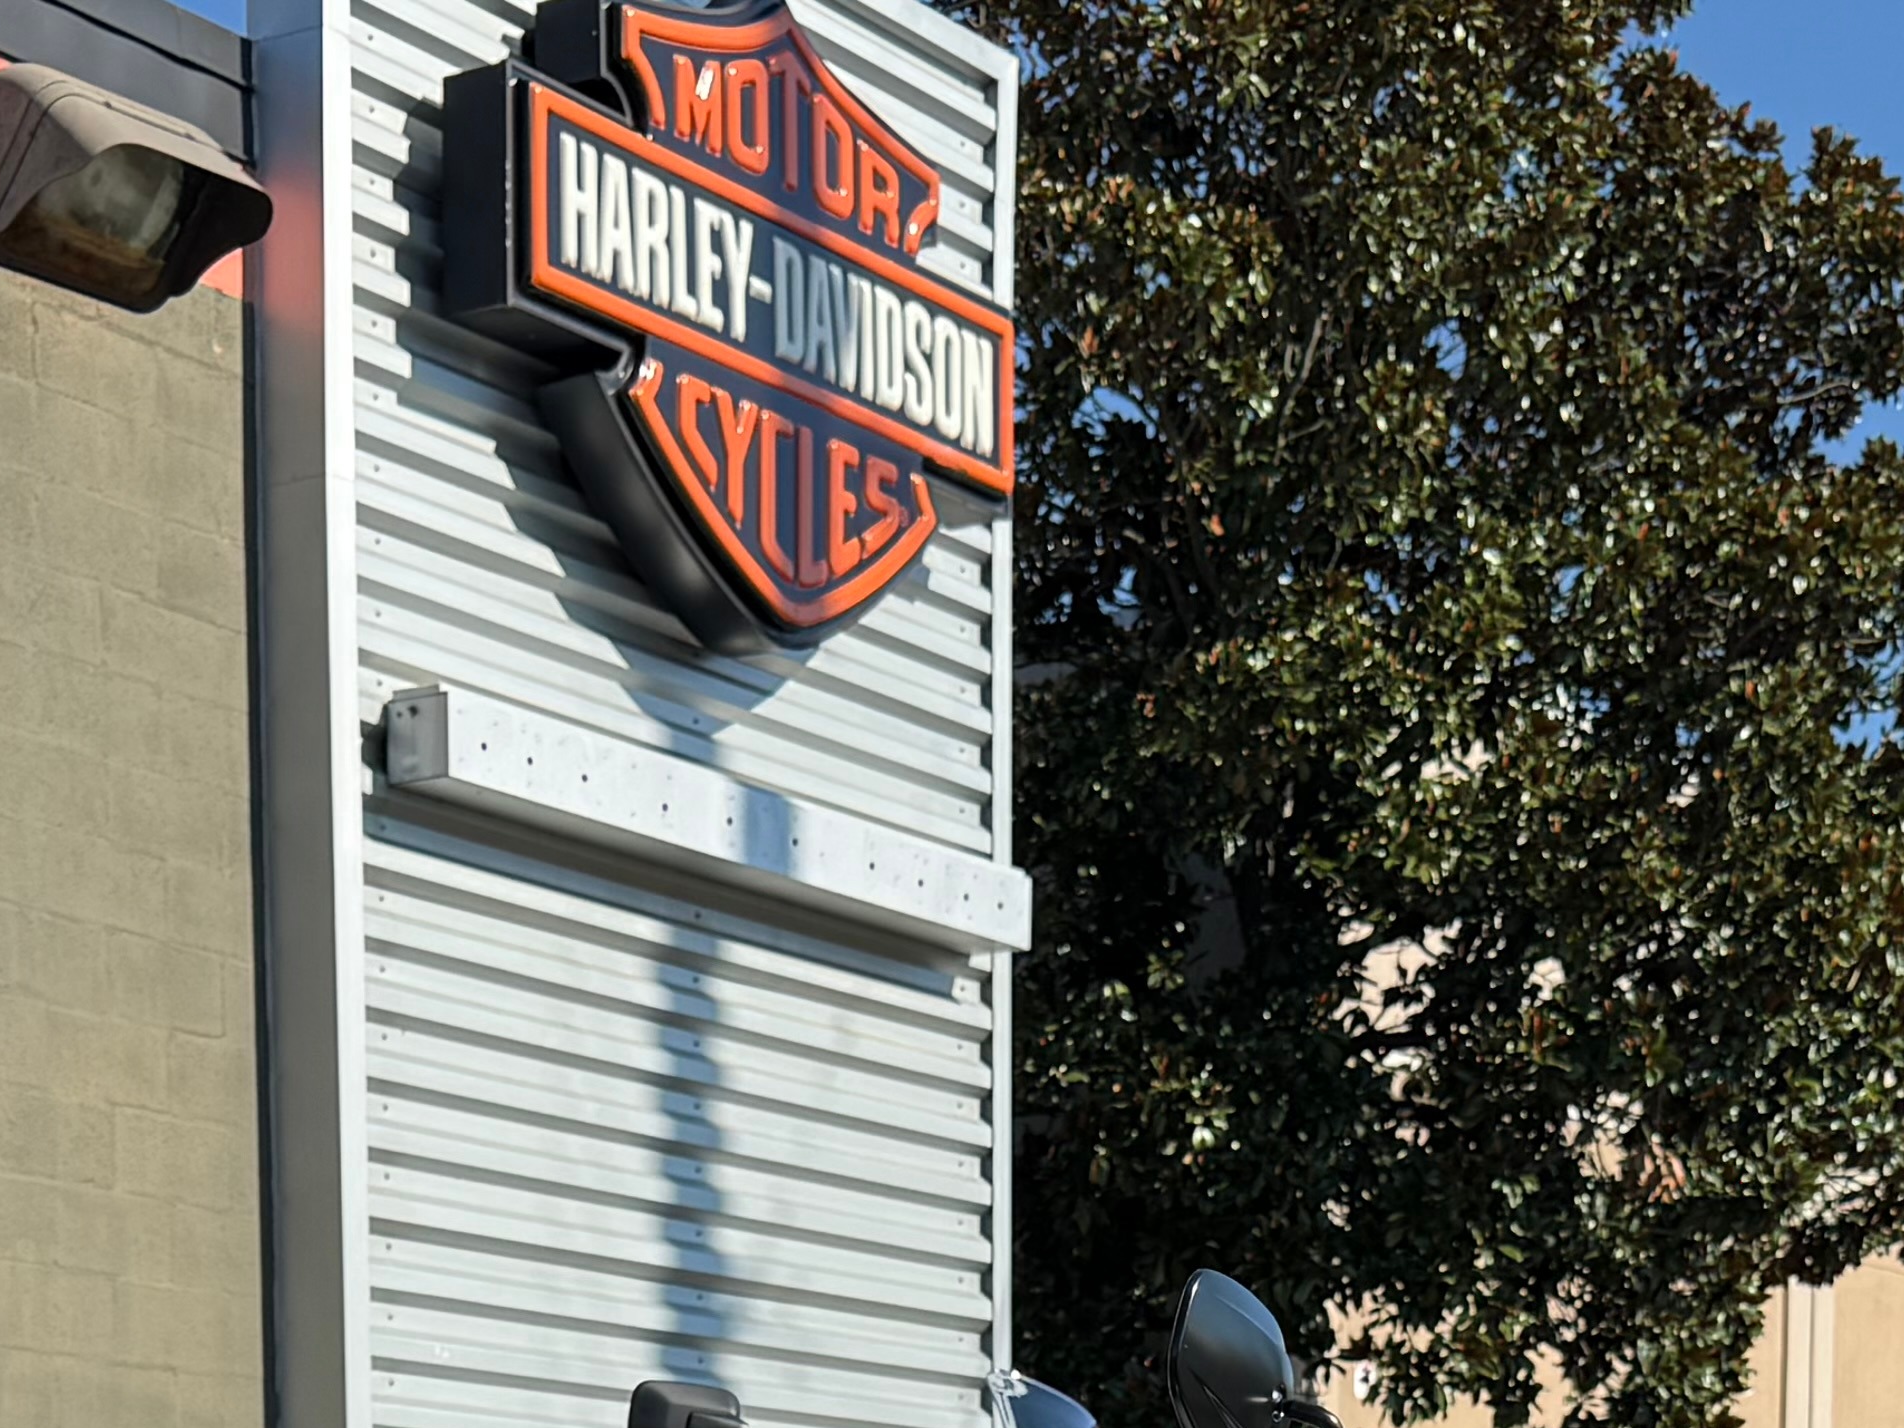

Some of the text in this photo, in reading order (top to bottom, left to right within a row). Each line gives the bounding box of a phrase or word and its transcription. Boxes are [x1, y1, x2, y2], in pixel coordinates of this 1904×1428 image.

[672, 52, 902, 249] MOTOR
[559, 131, 994, 458] HARLEY-DAVIDSON
[675, 373, 900, 589] CYCLES
